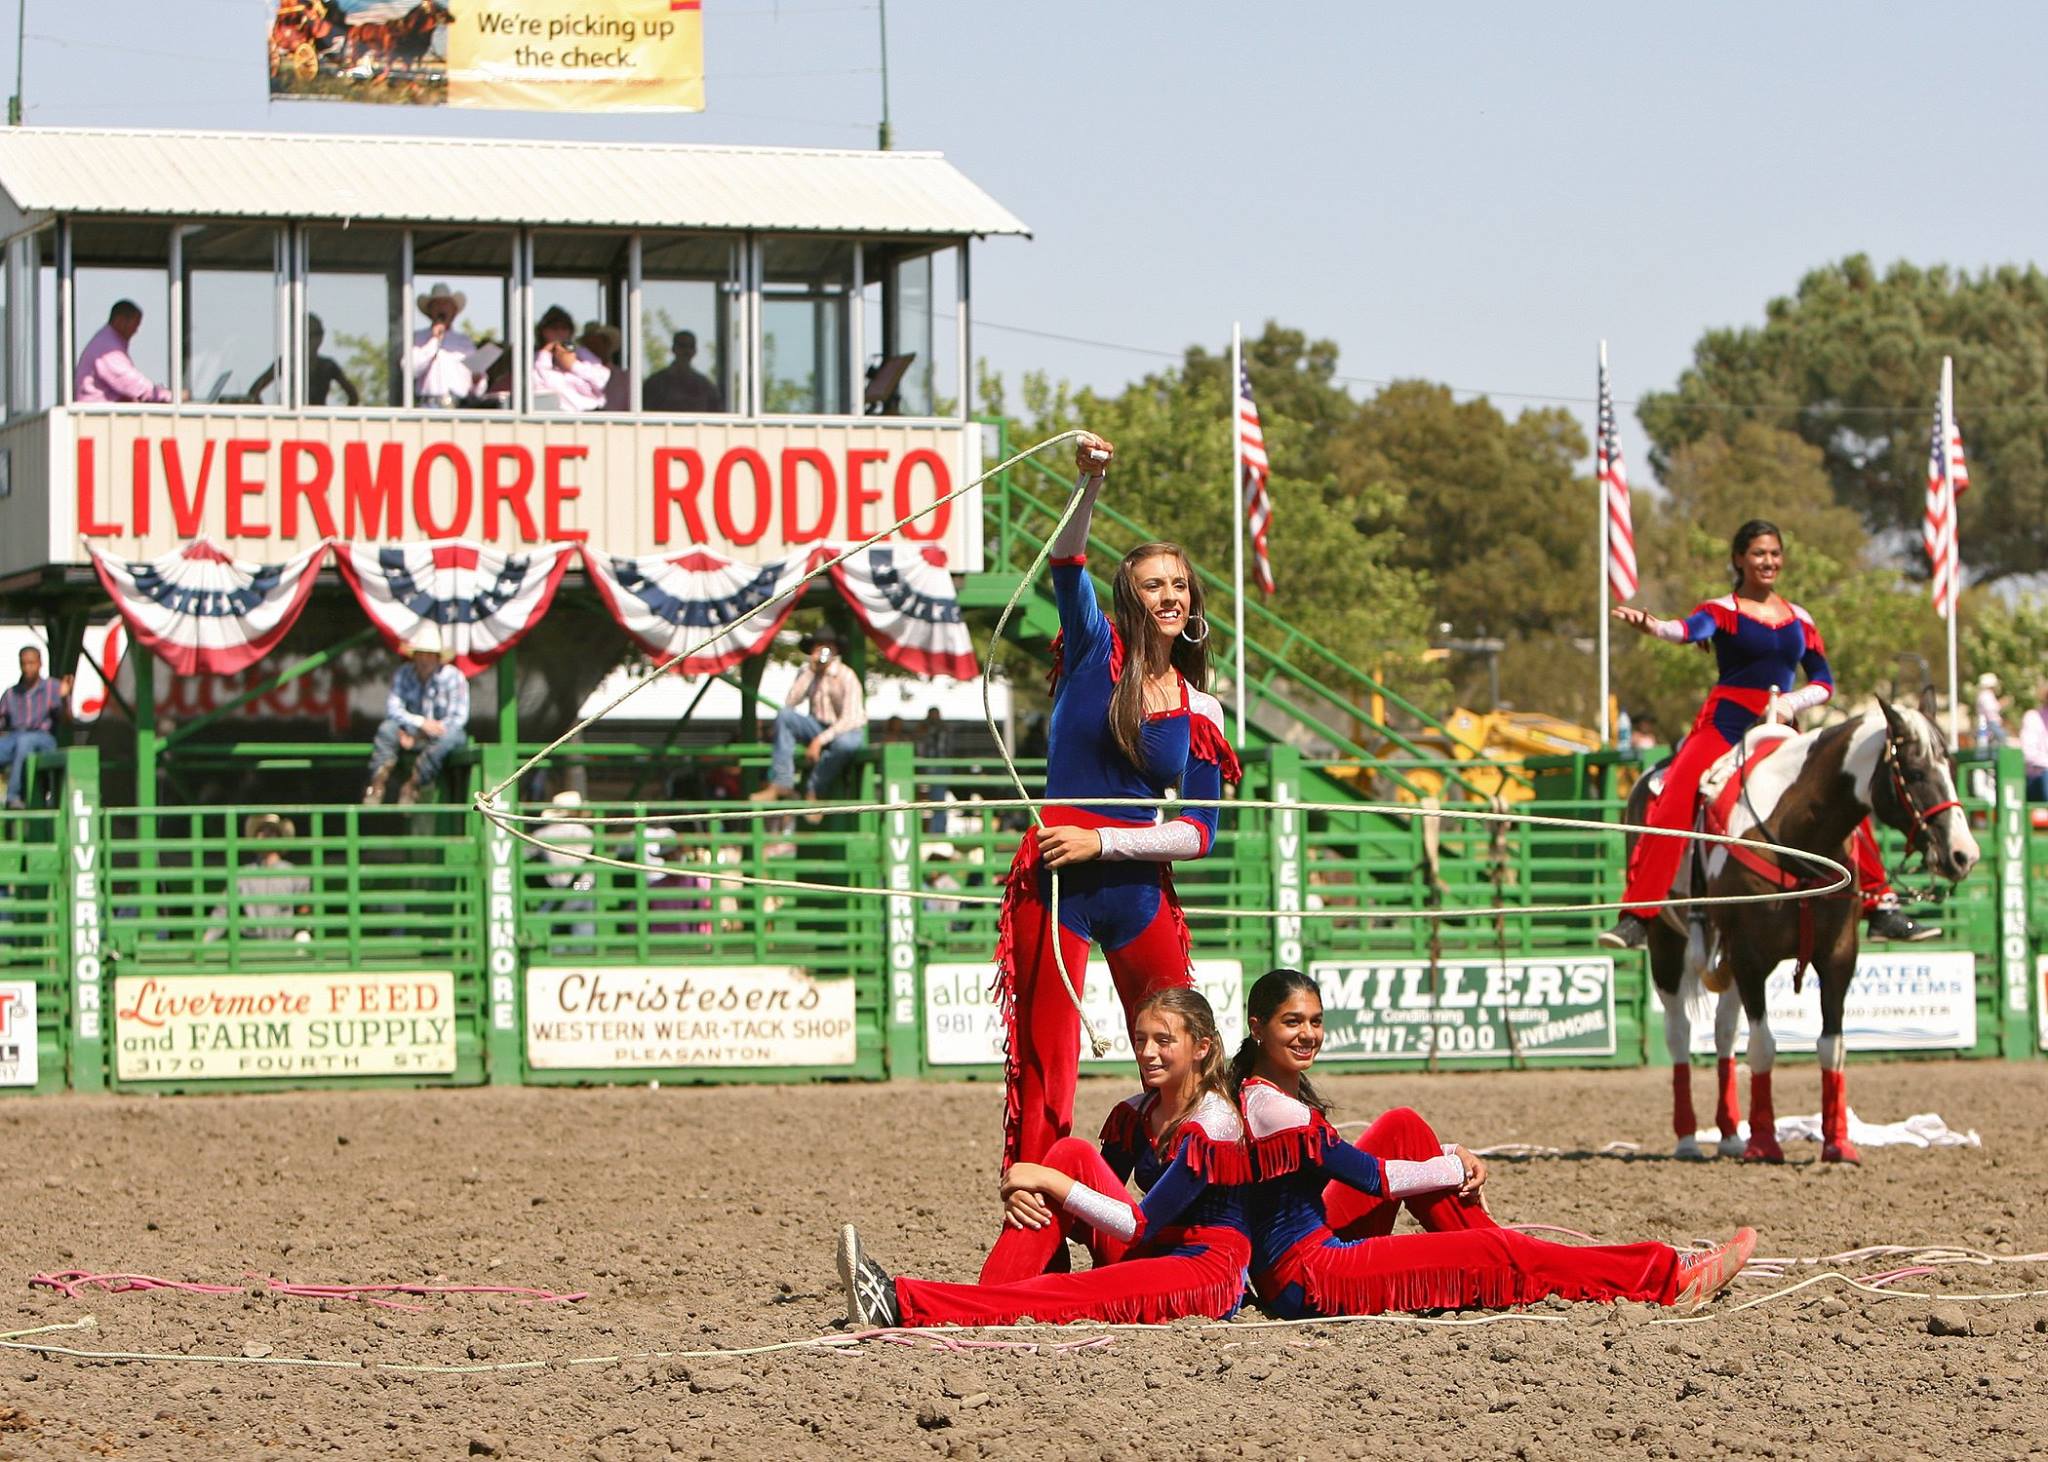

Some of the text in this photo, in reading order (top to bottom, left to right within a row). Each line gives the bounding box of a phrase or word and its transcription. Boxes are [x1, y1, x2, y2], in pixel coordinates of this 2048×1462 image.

[549, 12, 636, 42] picking
[643, 17, 675, 41] up
[514, 45, 637, 68] the check.
[78, 437, 952, 546] LIVERMORE RODEO
[1276, 781, 1303, 968] LIVERMO
[72, 789, 99, 1039] LIVERMORE
[490, 789, 515, 1030] LIVERMORE
[888, 784, 914, 1024] LIVERMORE
[2003, 784, 2028, 1012] LIVERMORE
[119, 977, 439, 1028] Livermore FEED
[933, 973, 1000, 1006] alde
[1317, 964, 1606, 1010] MILLER'S
[123, 1018, 450, 1053] and FARM SUPPLY
[533, 1021, 646, 1042] WESTERN
[793, 1020, 851, 1038] SHOP
[936, 1013, 974, 1034] 981
[1358, 1025, 1496, 1052] 447-3000
[136, 1059, 205, 1073] 3170
[239, 1055, 360, 1071] FOURTH
[615, 1047, 770, 1061] PLEASANTON
